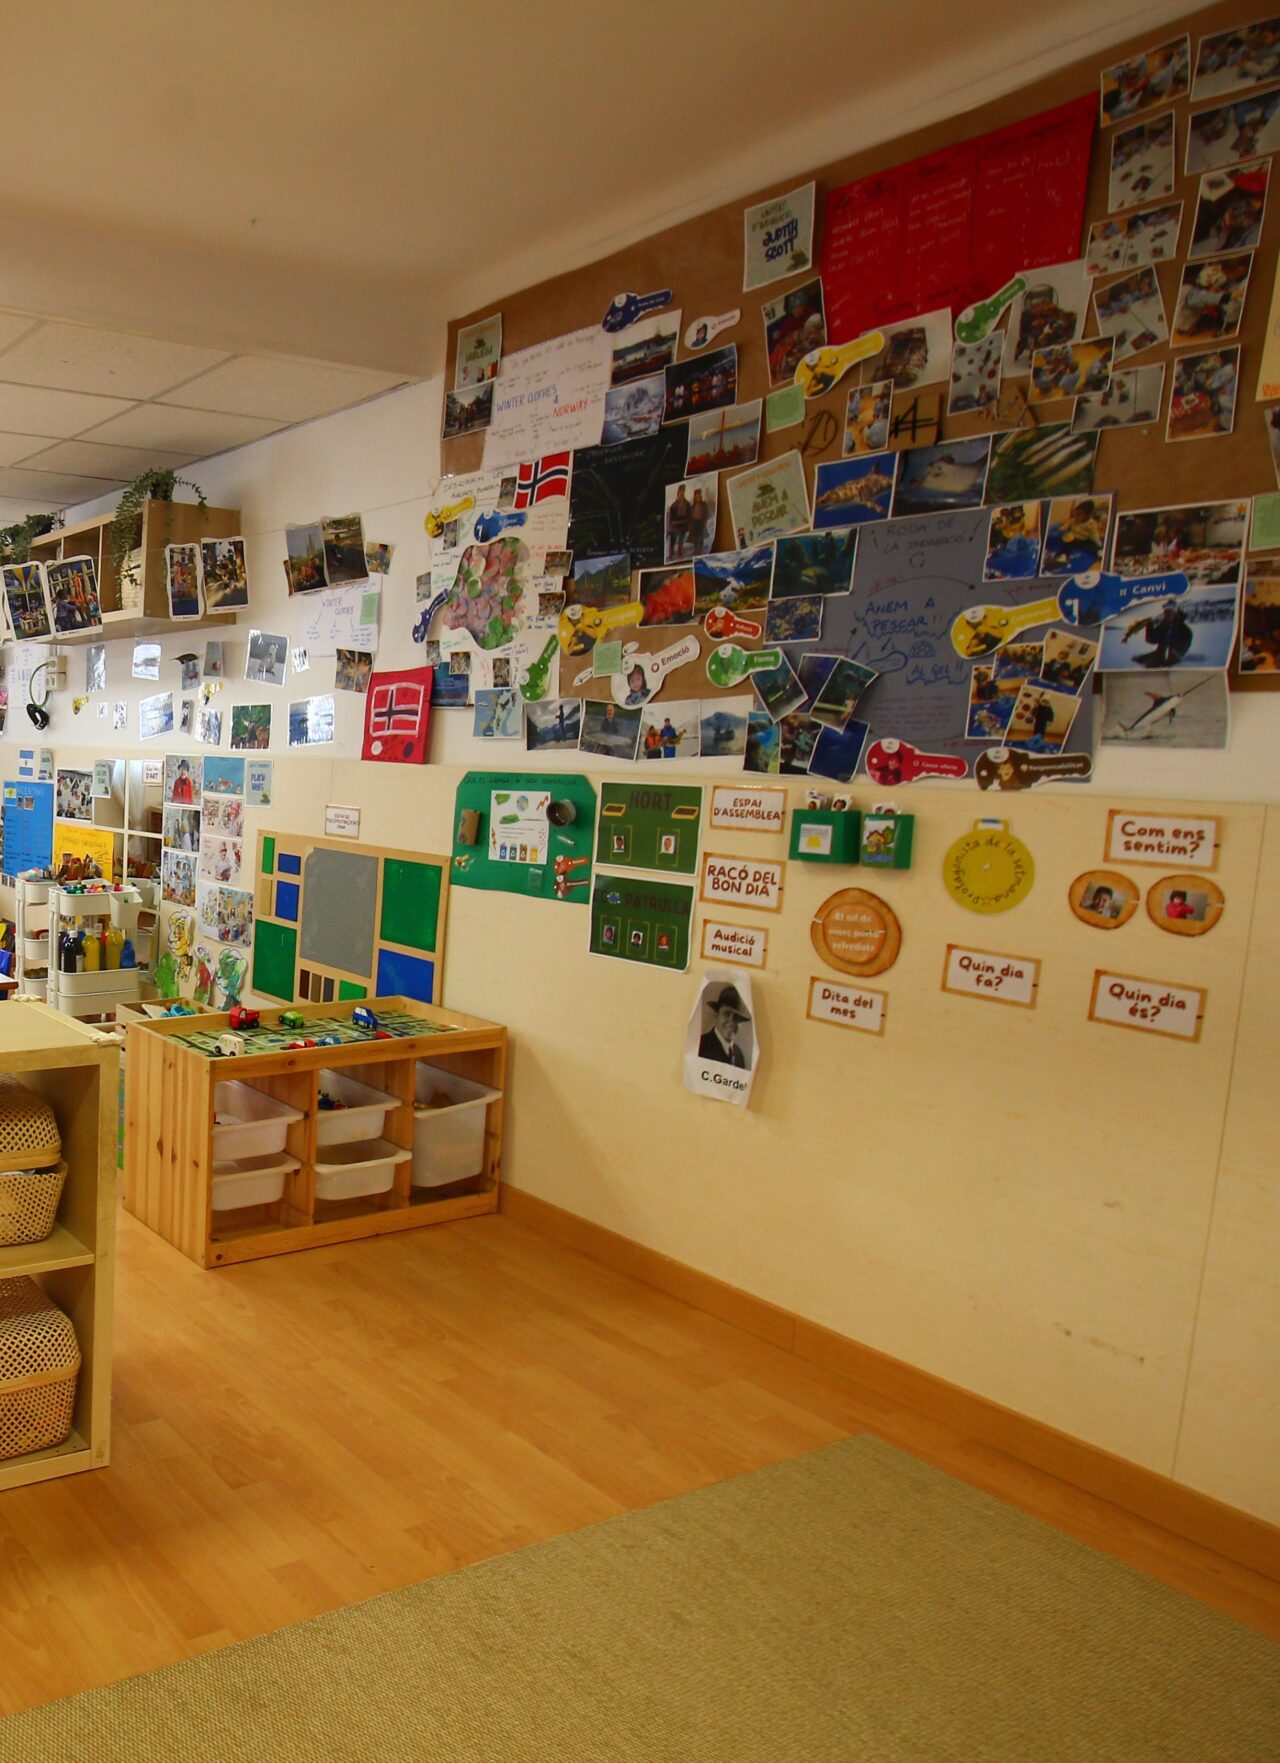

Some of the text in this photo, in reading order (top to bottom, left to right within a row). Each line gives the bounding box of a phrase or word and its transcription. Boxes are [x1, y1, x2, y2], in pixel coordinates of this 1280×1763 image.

[763, 218, 798, 247] JUDITH
[765, 238, 794, 263] SCOTT
[496, 394, 525, 412] WINTER
[553, 399, 589, 418] NORWAY
[1132, 582, 1166, 595] Canvi
[866, 597, 935, 616] ANEM A
[661, 647, 690, 666] Emoció
[1028, 762, 1084, 772] Responsabilitat
[629, 791, 673, 811] HORT
[732, 798, 762, 808] ESPAI
[713, 808, 781, 821] D'ASSEMBLEA
[1120, 820, 1206, 842] Com ens
[1123, 837, 1200, 858] sentim?
[707, 864, 778, 886] RACÓ DEL
[952, 835, 1026, 905] protagonista de la setmana
[712, 878, 770, 898] BON DIA
[713, 928, 756, 945] Audició
[711, 943, 753, 958] musical
[958, 955, 1025, 980] Quin dia
[975, 975, 1004, 992] fa?
[821, 987, 874, 1010] Dita del
[1108, 982, 1187, 1011] Quin dia
[830, 1007, 857, 1020] mes
[1128, 1002, 1162, 1023] és?
